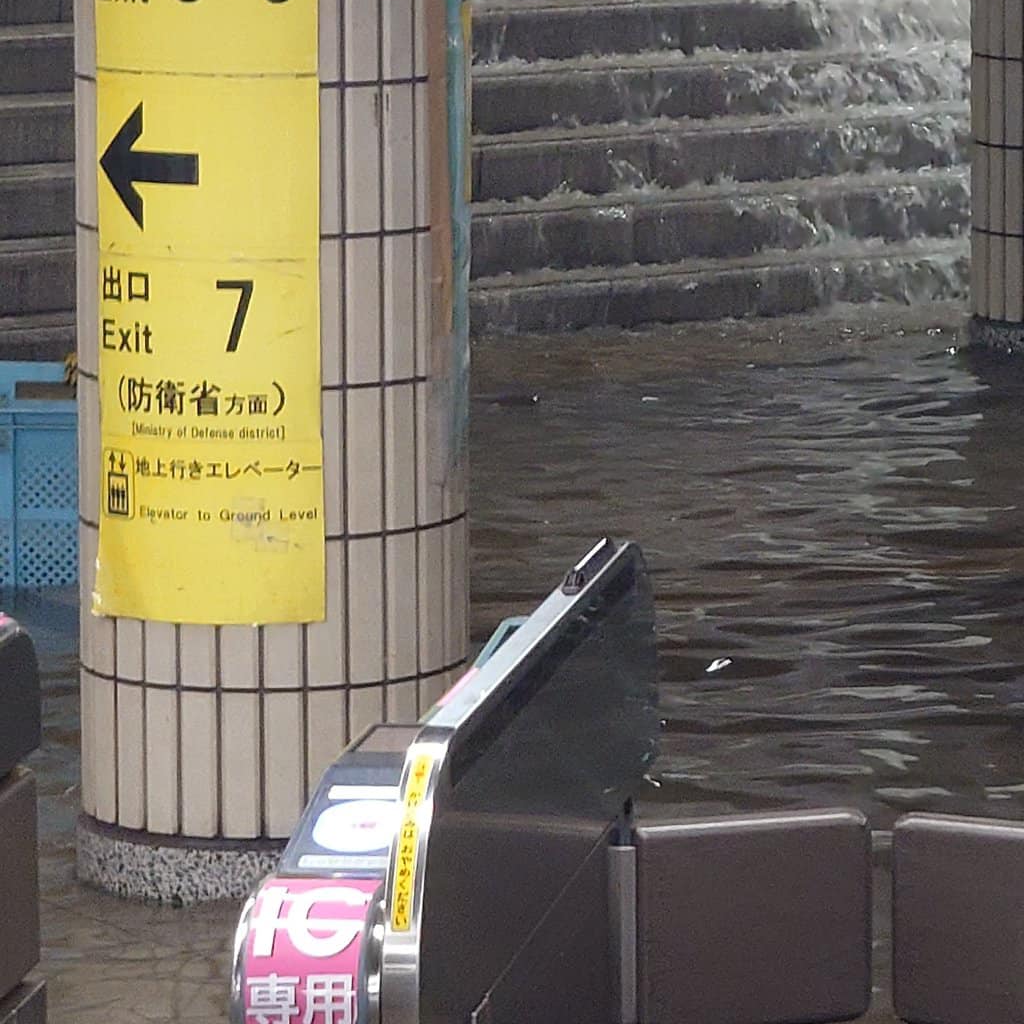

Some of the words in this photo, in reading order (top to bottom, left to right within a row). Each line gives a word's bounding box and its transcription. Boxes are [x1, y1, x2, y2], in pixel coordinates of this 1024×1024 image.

[102, 264, 151, 304] 出口
[215, 279, 255, 354] 7
[101, 318, 154, 355] Exit
[176, 425, 188, 438] of
[191, 426, 235, 439] Defense
[135, 456, 322, 481] 地上行きエレベーター
[139, 505, 188, 522] Elevator
[197, 508, 211, 522] to
[219, 508, 271, 523] Ground
[279, 507, 318, 521] Level
[250, 884, 374, 958] IC
[245, 972, 358, 1024] 専用
